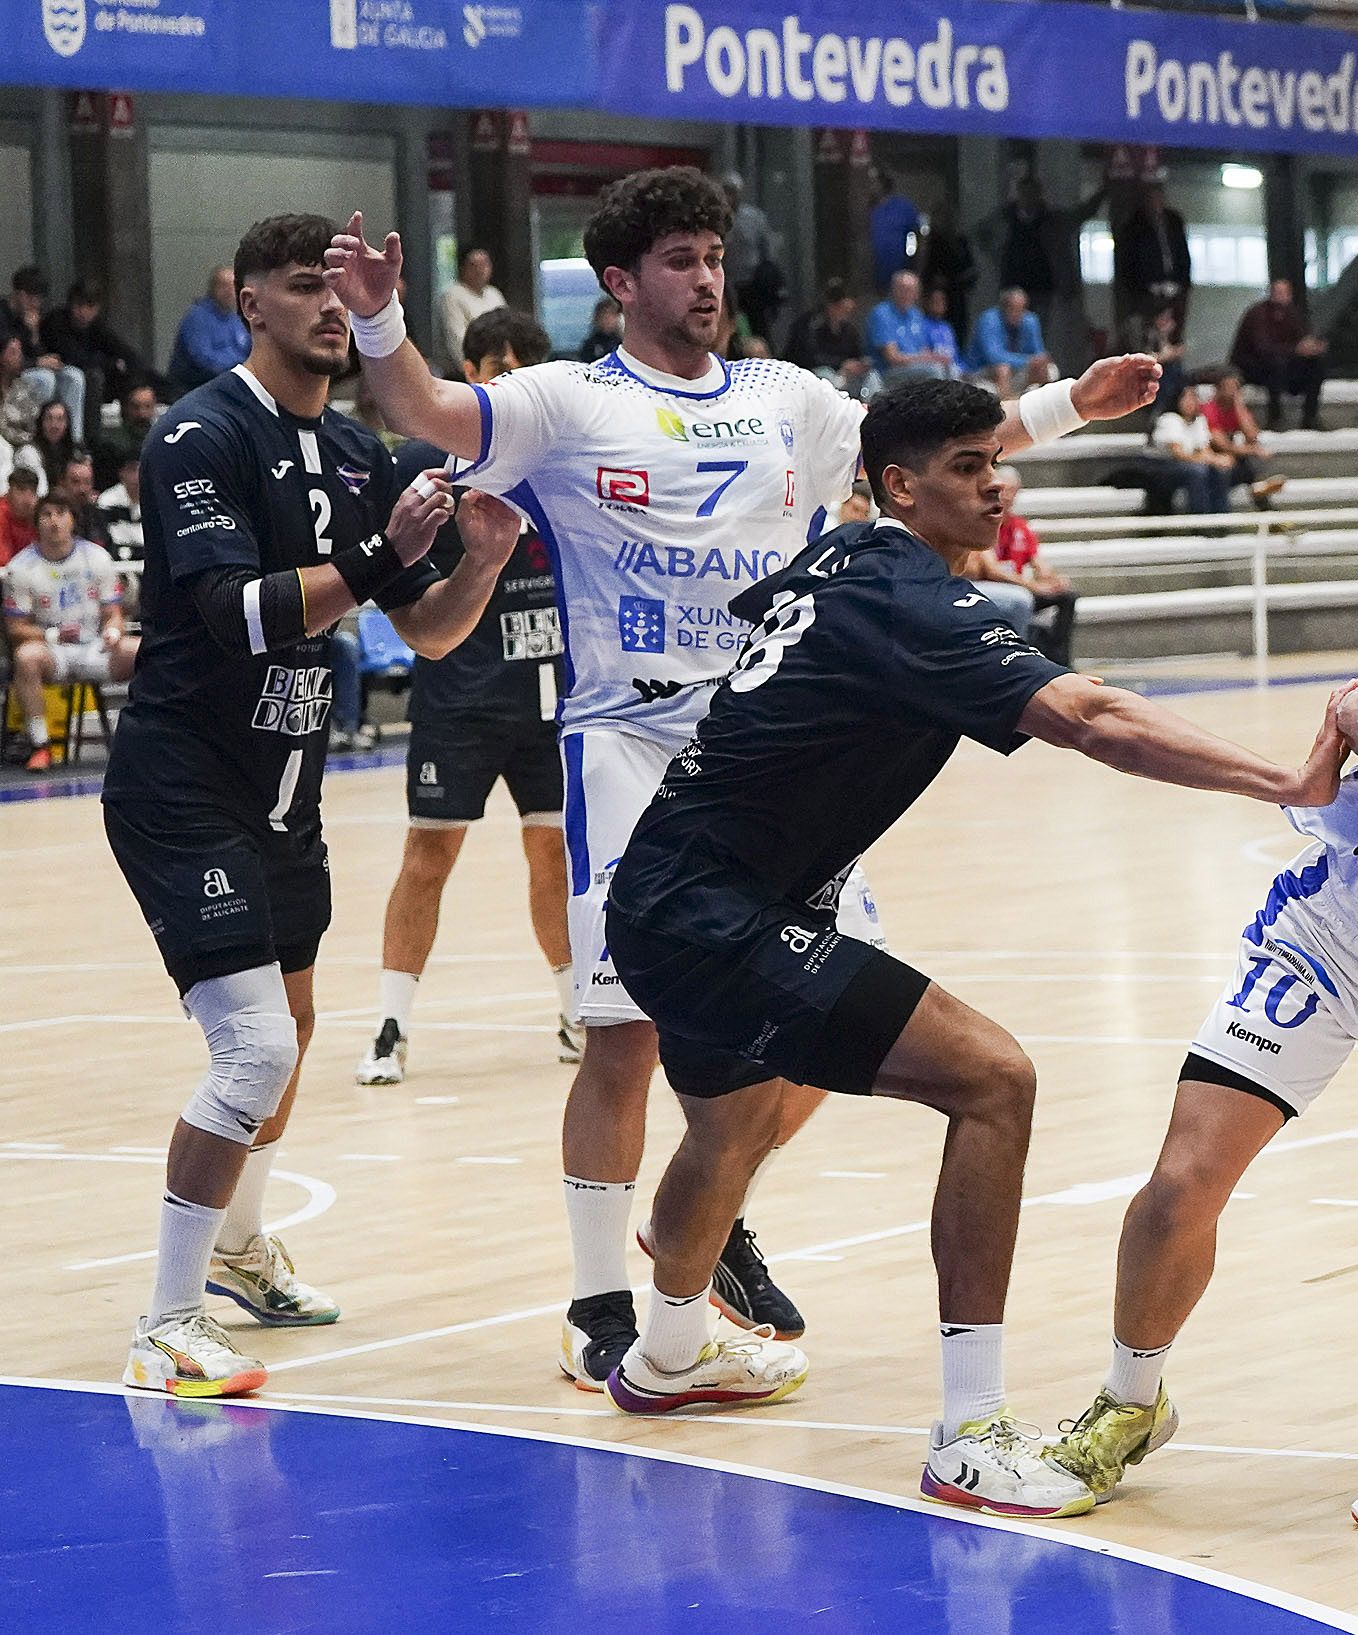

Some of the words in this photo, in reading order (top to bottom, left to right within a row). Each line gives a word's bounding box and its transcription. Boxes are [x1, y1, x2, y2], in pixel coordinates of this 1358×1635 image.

[664, 3, 1010, 112] Pontevedra
[692, 418, 765, 438] ence
[173, 479, 216, 499] SER
[696, 461, 748, 518] 7
[177, 521, 215, 537] centauro
[308, 488, 333, 555] 2
[677, 630, 709, 648] DE
[1225, 956, 1321, 1028] 10
[1225, 1020, 1283, 1055] Kempa
